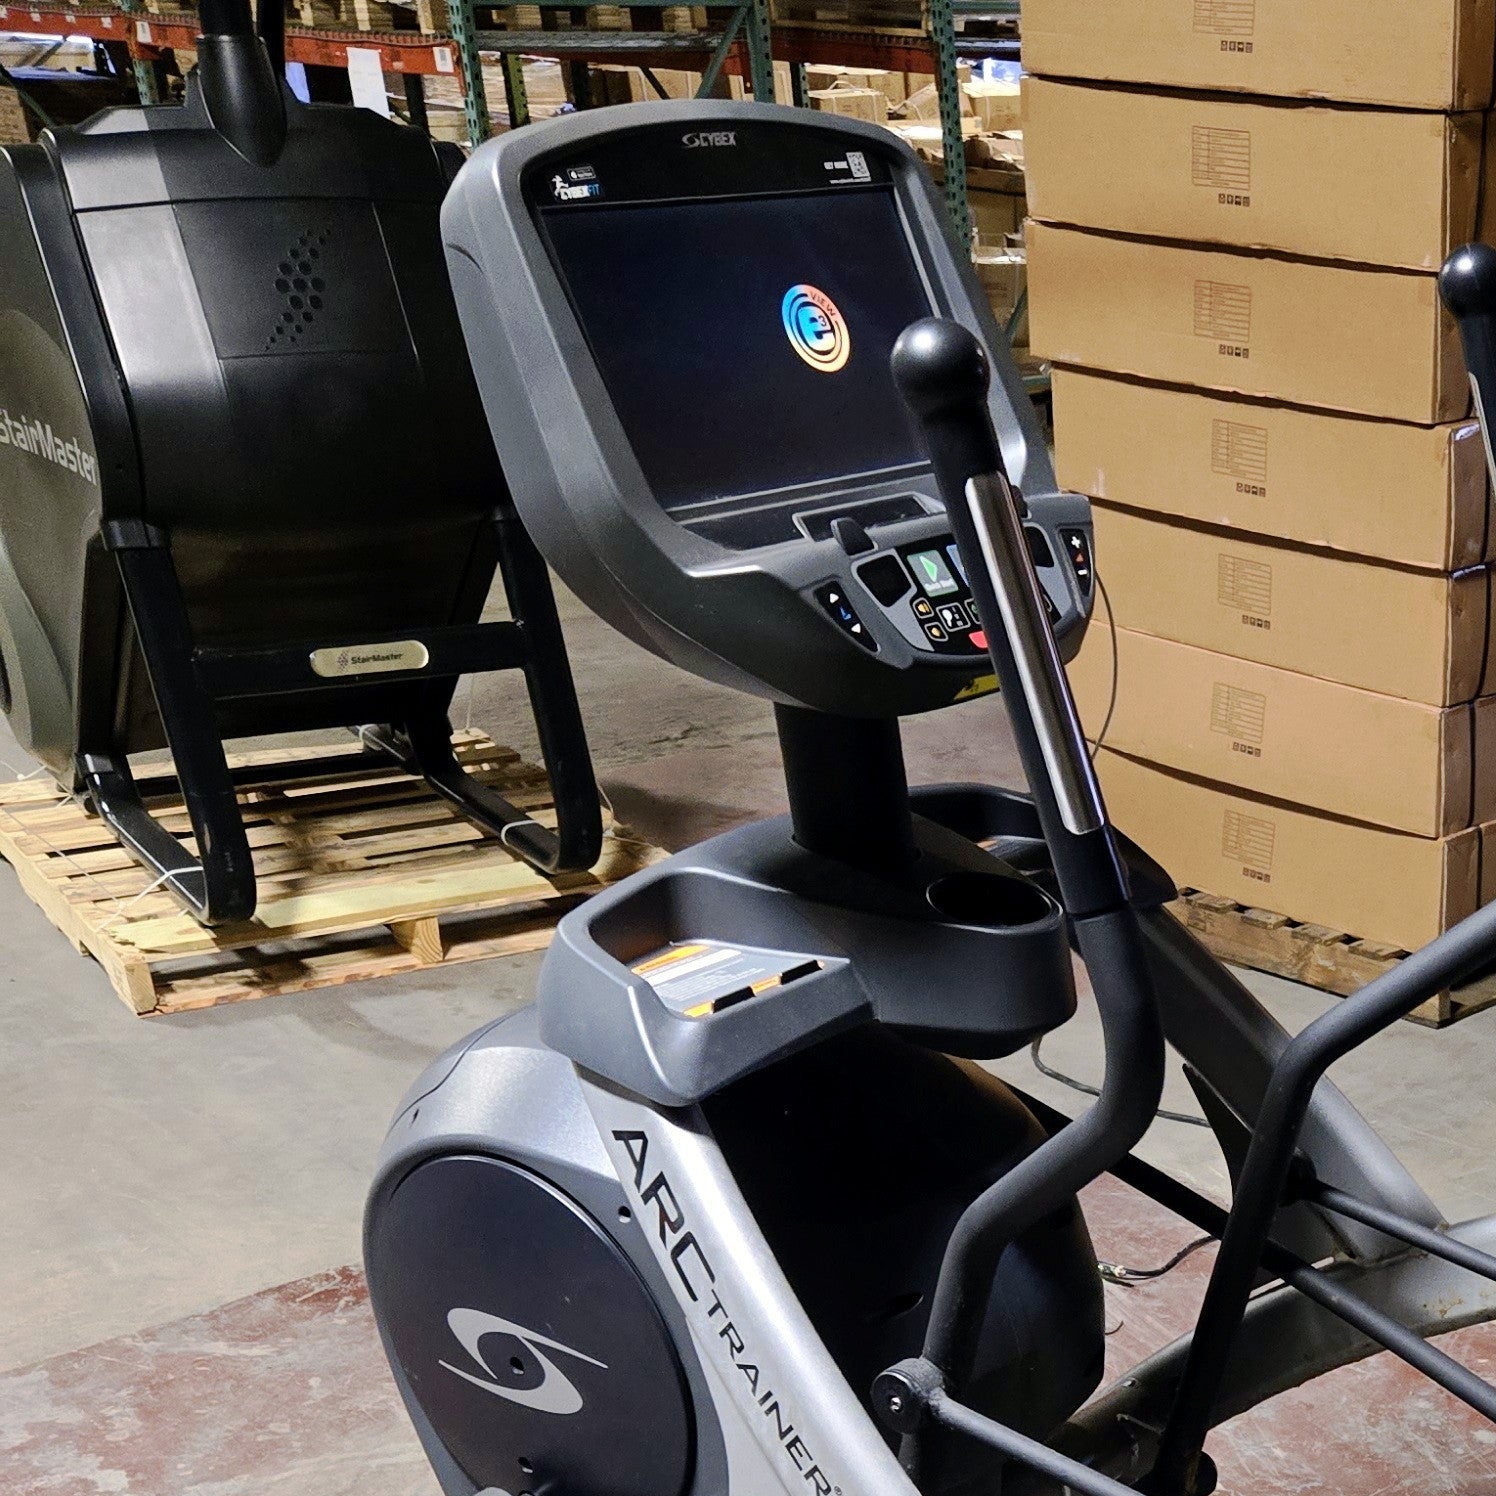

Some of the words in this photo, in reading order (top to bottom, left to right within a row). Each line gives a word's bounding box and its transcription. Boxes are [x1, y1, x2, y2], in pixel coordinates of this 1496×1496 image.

[700, 131, 737, 147] CYBEX
[809, 290, 836, 317] VIEW
[0, 409, 97, 486] StairMaster
[351, 652, 403, 665] StairMaster
[611, 1129, 715, 1302] ARC
